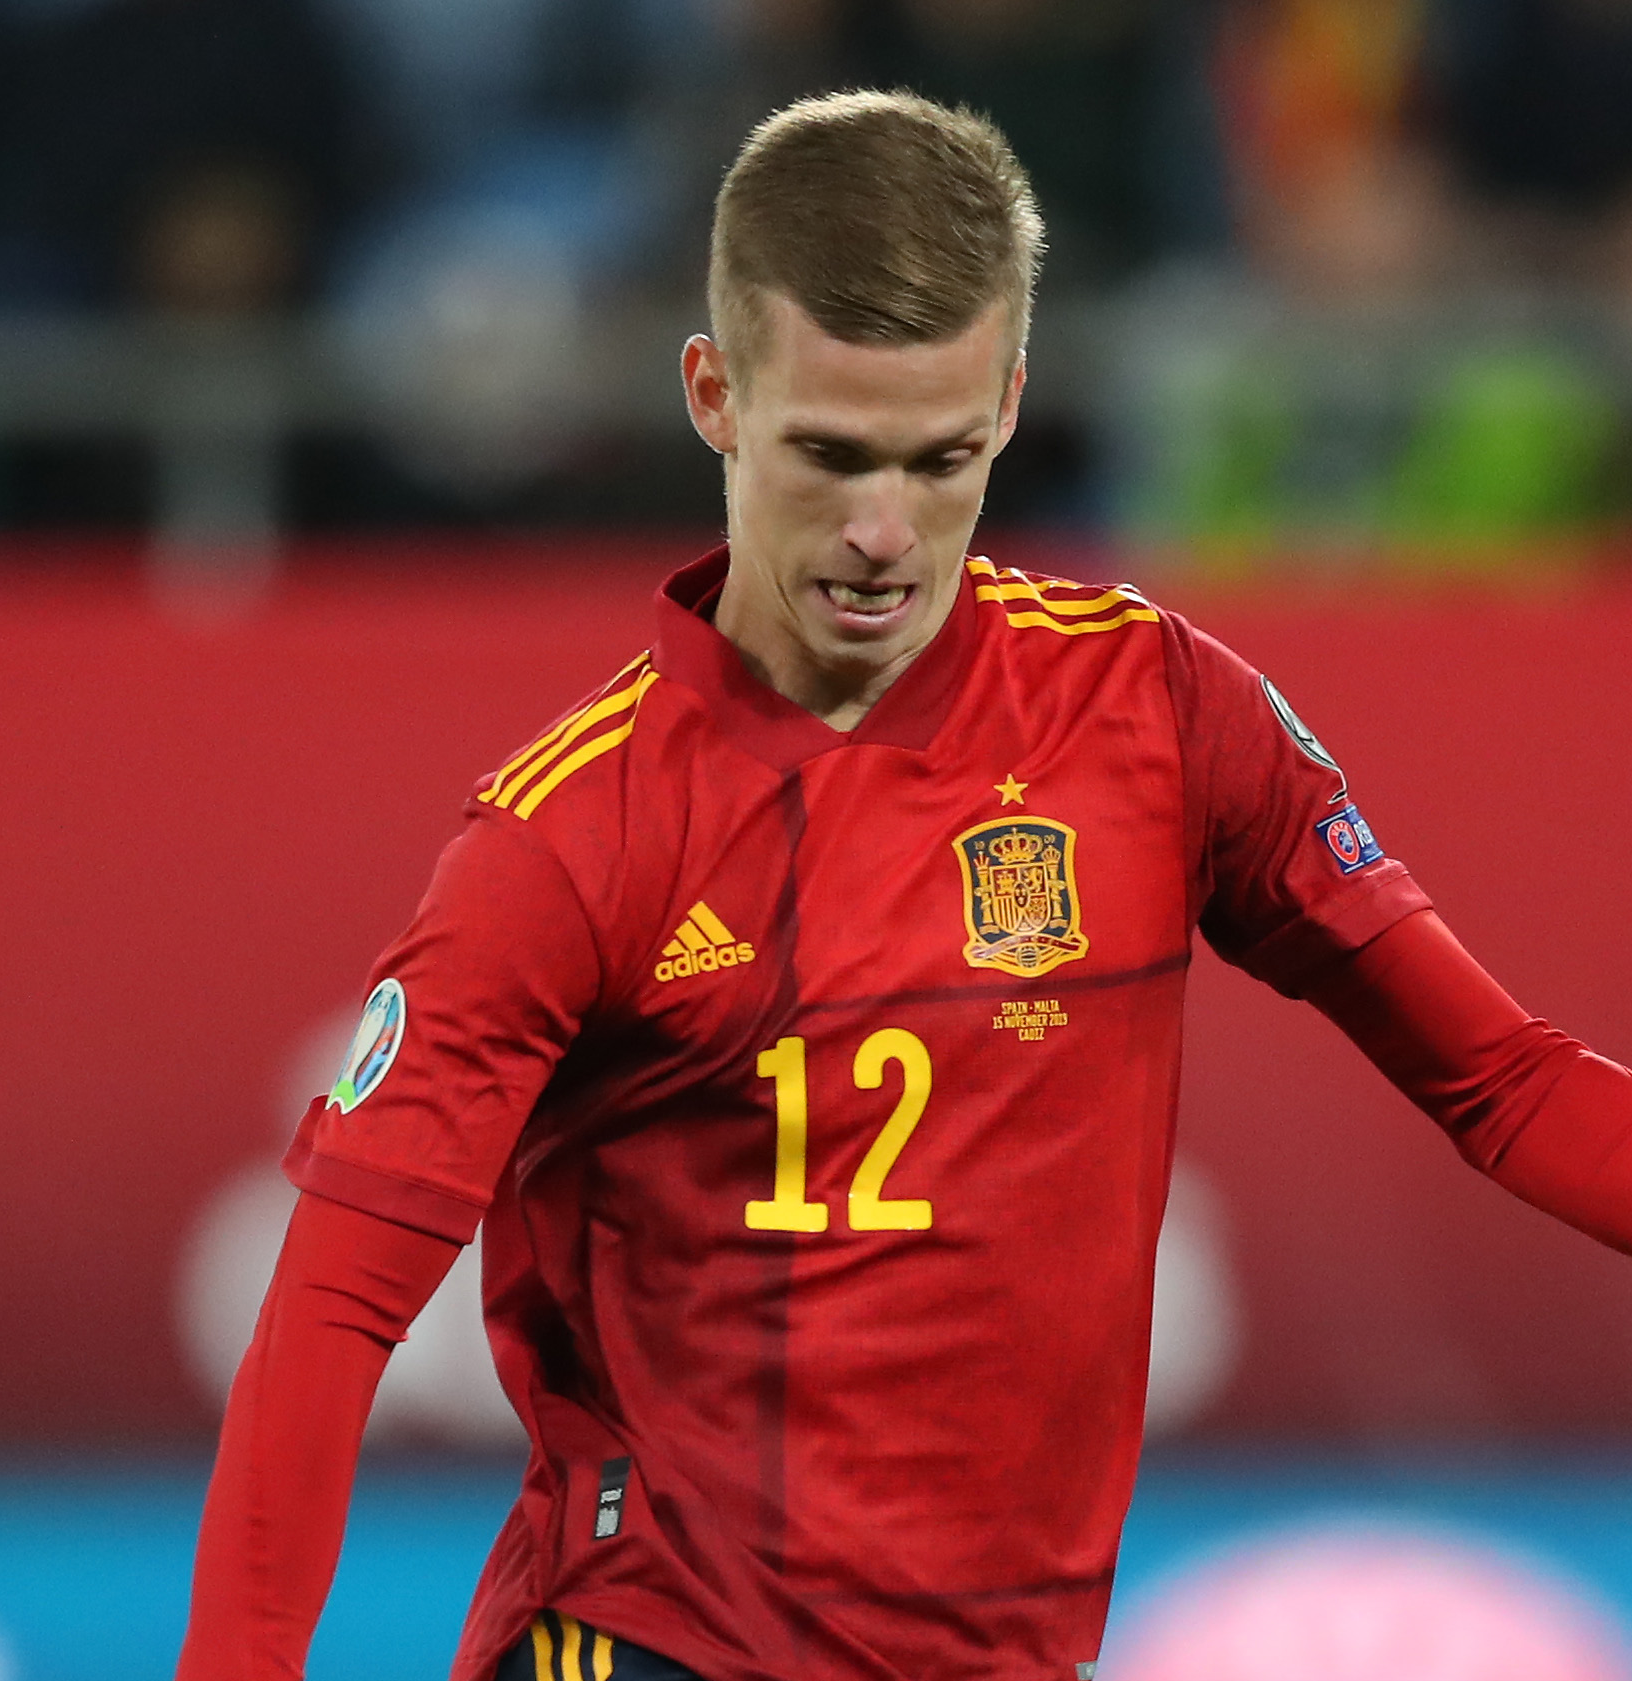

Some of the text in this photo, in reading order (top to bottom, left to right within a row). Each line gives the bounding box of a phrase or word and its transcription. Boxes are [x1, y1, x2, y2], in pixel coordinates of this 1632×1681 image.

[655, 942, 756, 982] adidas
[1001, 1002, 1028, 1015] SPAIN
[1034, 1000, 1060, 1013] MALTA
[993, 1016, 1003, 1029] 15
[1004, 1014, 1048, 1028] NOVEMBER
[745, 1027, 933, 1232] 12
